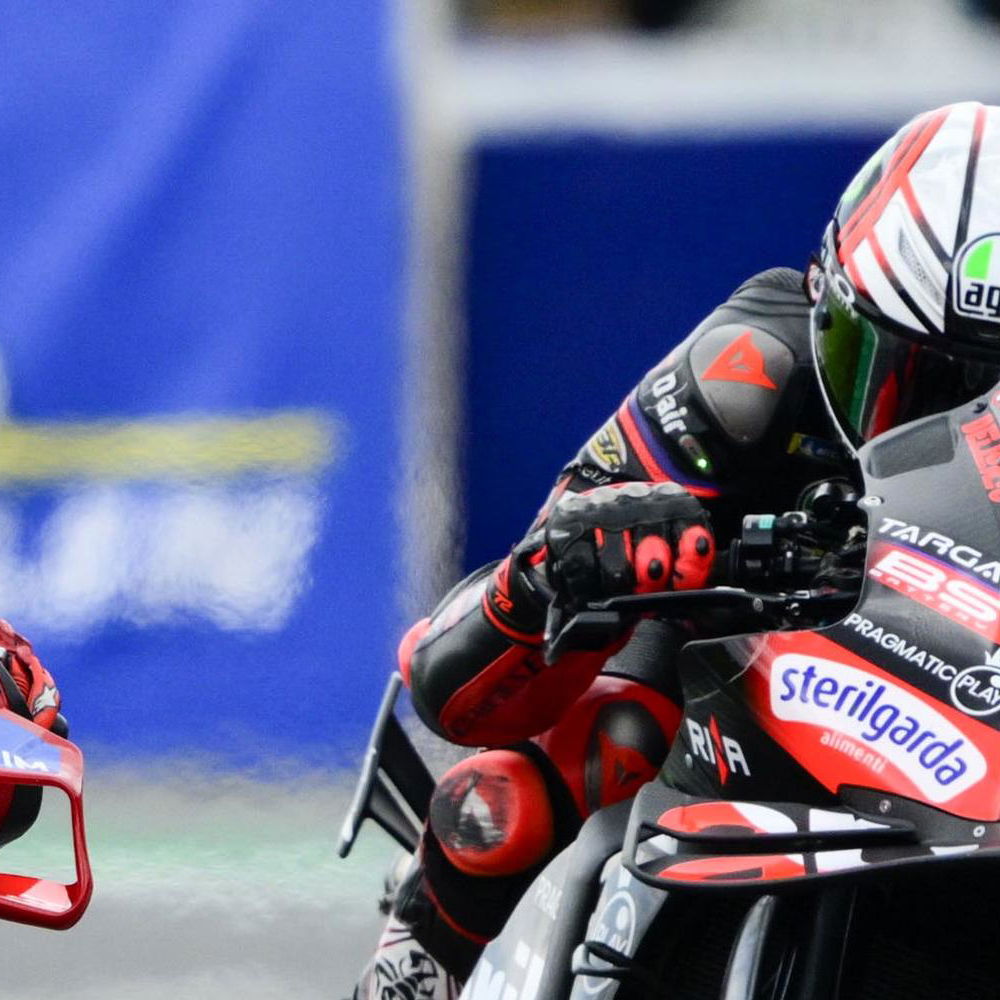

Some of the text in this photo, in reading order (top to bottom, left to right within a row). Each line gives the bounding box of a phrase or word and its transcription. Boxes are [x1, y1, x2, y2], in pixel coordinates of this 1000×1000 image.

[843, 613, 957, 682] PRAGMATIC
[780, 665, 967, 786] sterilgarda
[820, 730, 886, 774] alimenti
